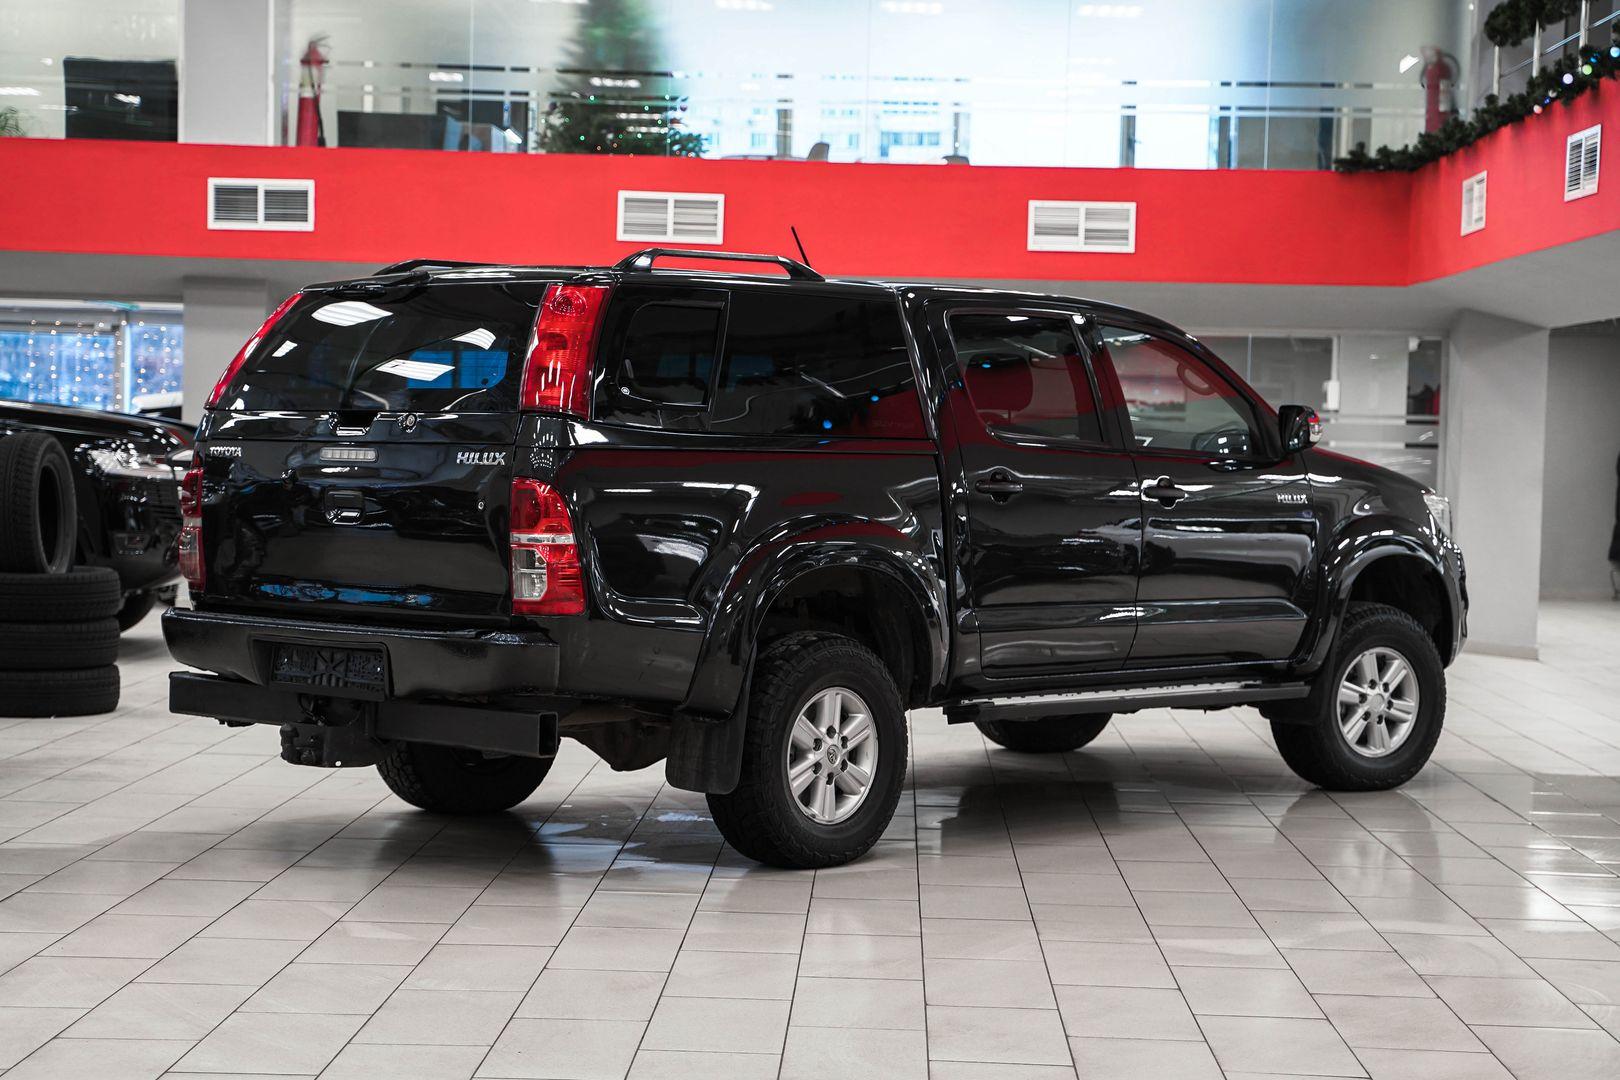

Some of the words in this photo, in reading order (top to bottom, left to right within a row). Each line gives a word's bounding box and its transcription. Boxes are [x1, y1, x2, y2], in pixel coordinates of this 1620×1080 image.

[209, 446, 242, 457] TOYOTA
[456, 452, 506, 466] HILUX
[1276, 492, 1308, 504] HILUX
